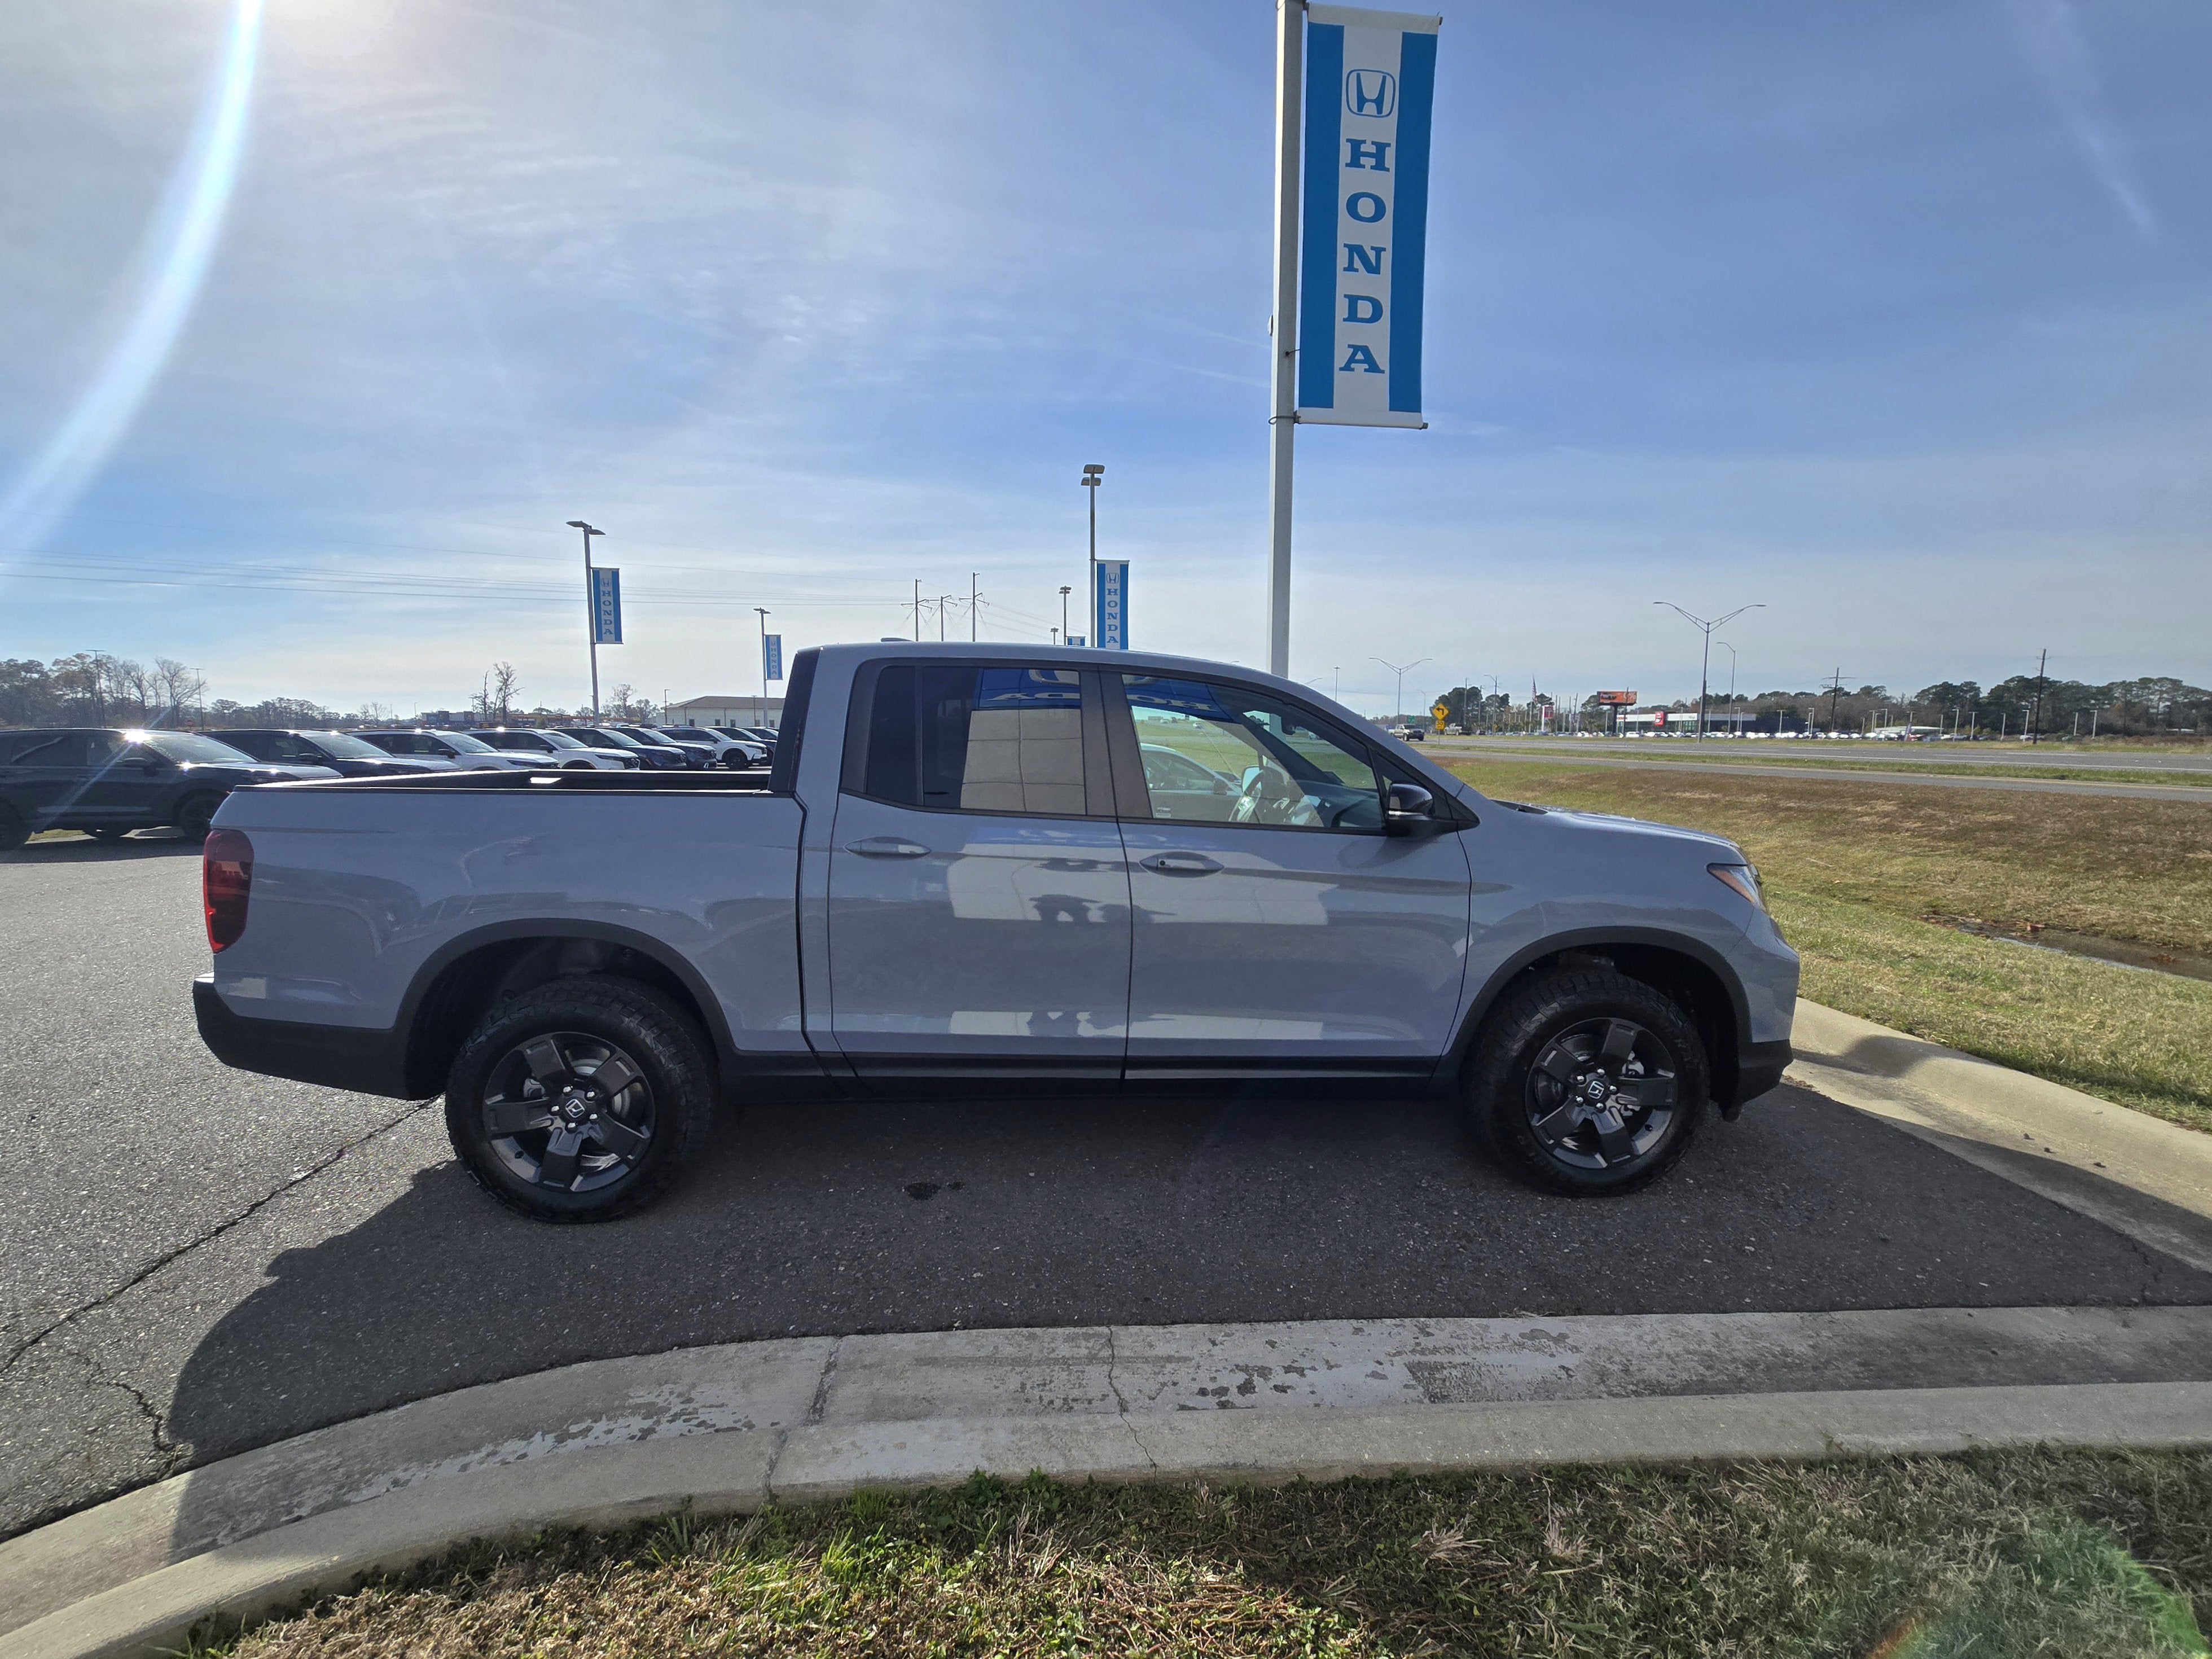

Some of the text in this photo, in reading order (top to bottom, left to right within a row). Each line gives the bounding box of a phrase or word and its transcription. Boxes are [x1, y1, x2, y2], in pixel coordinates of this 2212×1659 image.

[1339, 138, 1390, 374] HONDA
[602, 590, 613, 635] HONDA
[1107, 588, 1119, 643] HONDA
